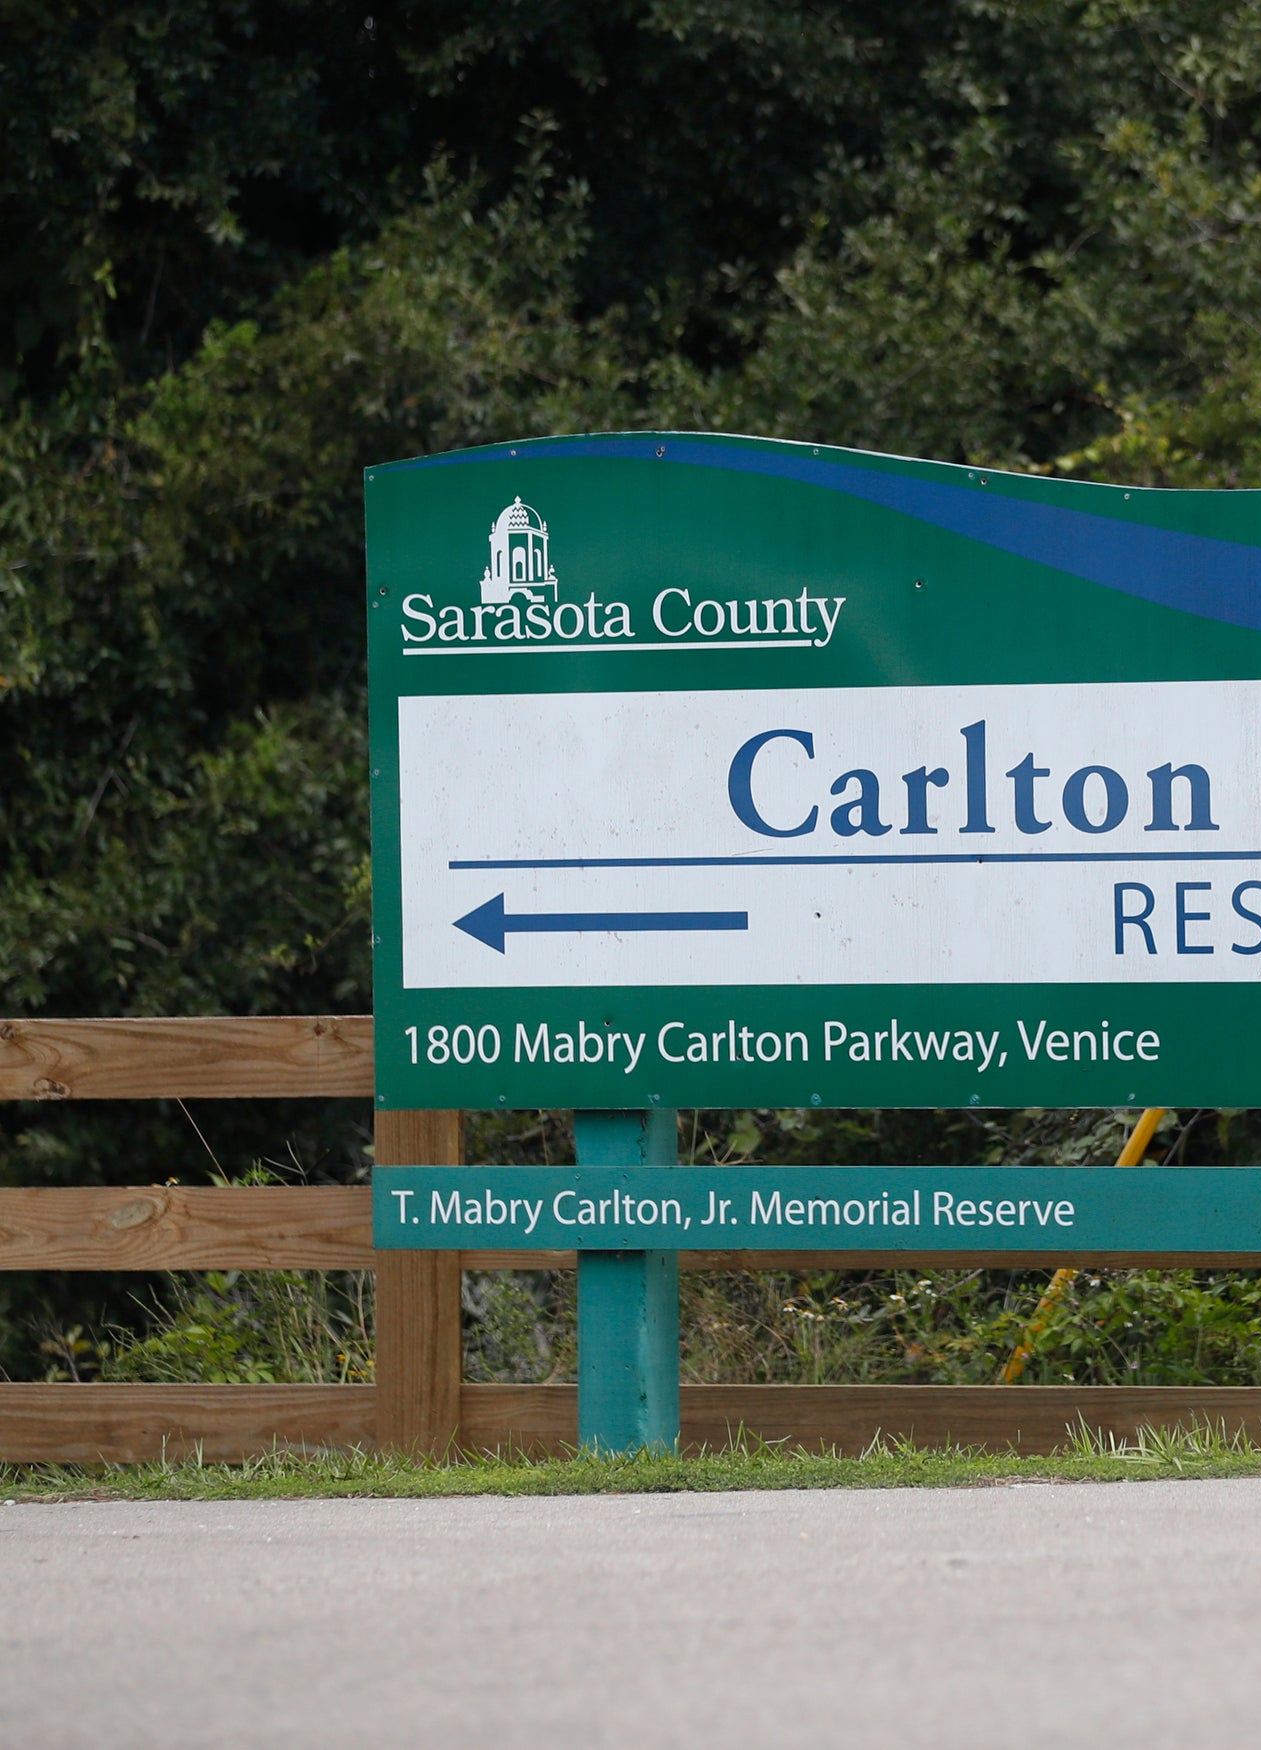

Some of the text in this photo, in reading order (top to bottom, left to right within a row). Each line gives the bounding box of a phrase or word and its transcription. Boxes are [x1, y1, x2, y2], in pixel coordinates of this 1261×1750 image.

[400, 586, 847, 648] Sarasota County
[727, 719, 1220, 839] Carlton
[403, 1019, 1160, 1074] 1800 Mabry Carlton Parkway, Venice
[391, 1188, 1075, 1235] T. Mabry Carlton, Jr. Memorial Reserve
